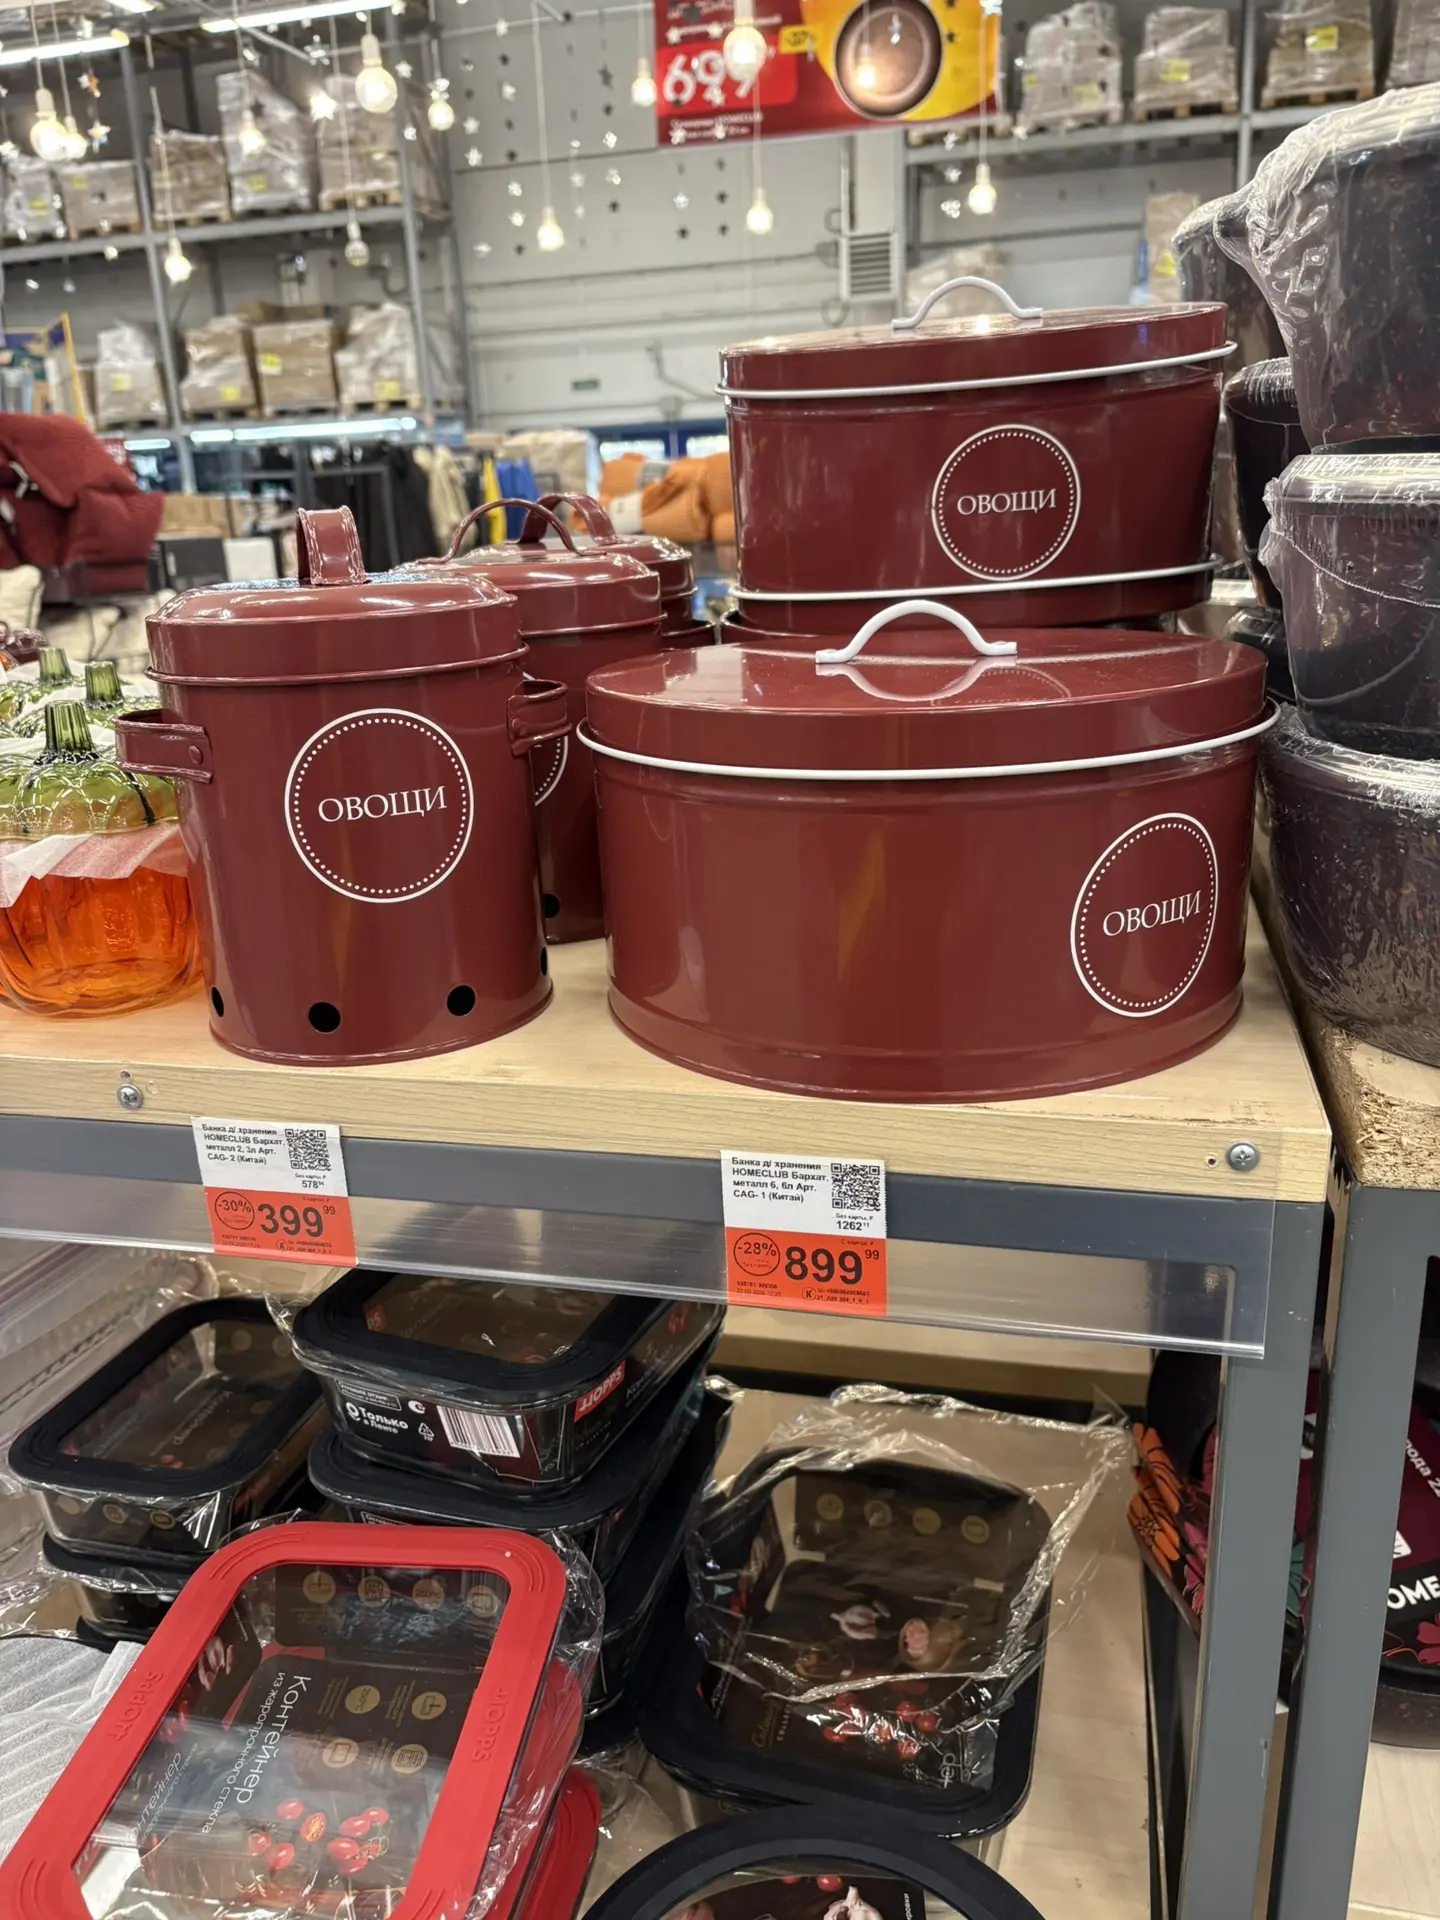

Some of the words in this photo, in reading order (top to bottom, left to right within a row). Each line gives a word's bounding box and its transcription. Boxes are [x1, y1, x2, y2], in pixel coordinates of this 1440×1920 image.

[956, 488, 1057, 515] ОВОЩИ
[318, 786, 447, 822] ОВОЩИ
[1102, 890, 1202, 936] ОВОЩИ
[204, 1133, 251, 1144] HOMECLUB
[238, 1127, 277, 1135] хранения
[206, 1144, 236, 1152] металл
[258, 1147, 276, 1155] Арт.
[237, 1155, 267, 1165] (Китай)
[732, 1157, 760, 1166] Банка
[775, 1161, 821, 1170] хранения
[732, 1168, 788, 1178] HOMECLUB
[302, 1180, 318, 1189] 578
[733, 1180, 768, 1188] металл
[781, 1181, 793, 1190] 6л
[796, 1183, 817, 1192] Арт.
[768, 1191, 804, 1203] (Китай)
[257, 1203, 323, 1238] 399
[323, 1205, 336, 1215] 99
[836, 1220, 862, 1231] 1262
[738, 1241, 776, 1256] -28%
[785, 1246, 862, 1285] 899
[864, 1249, 880, 1260] 99
[359, 1406, 408, 1429] Только
[273, 1672, 286, 1687] из
[227, 1689, 278, 1785] жаропрочного
[234, 1675, 311, 1804] Контейнер
[131, 1752, 181, 1840] онтейнер
[201, 1786, 231, 1834] стекла
